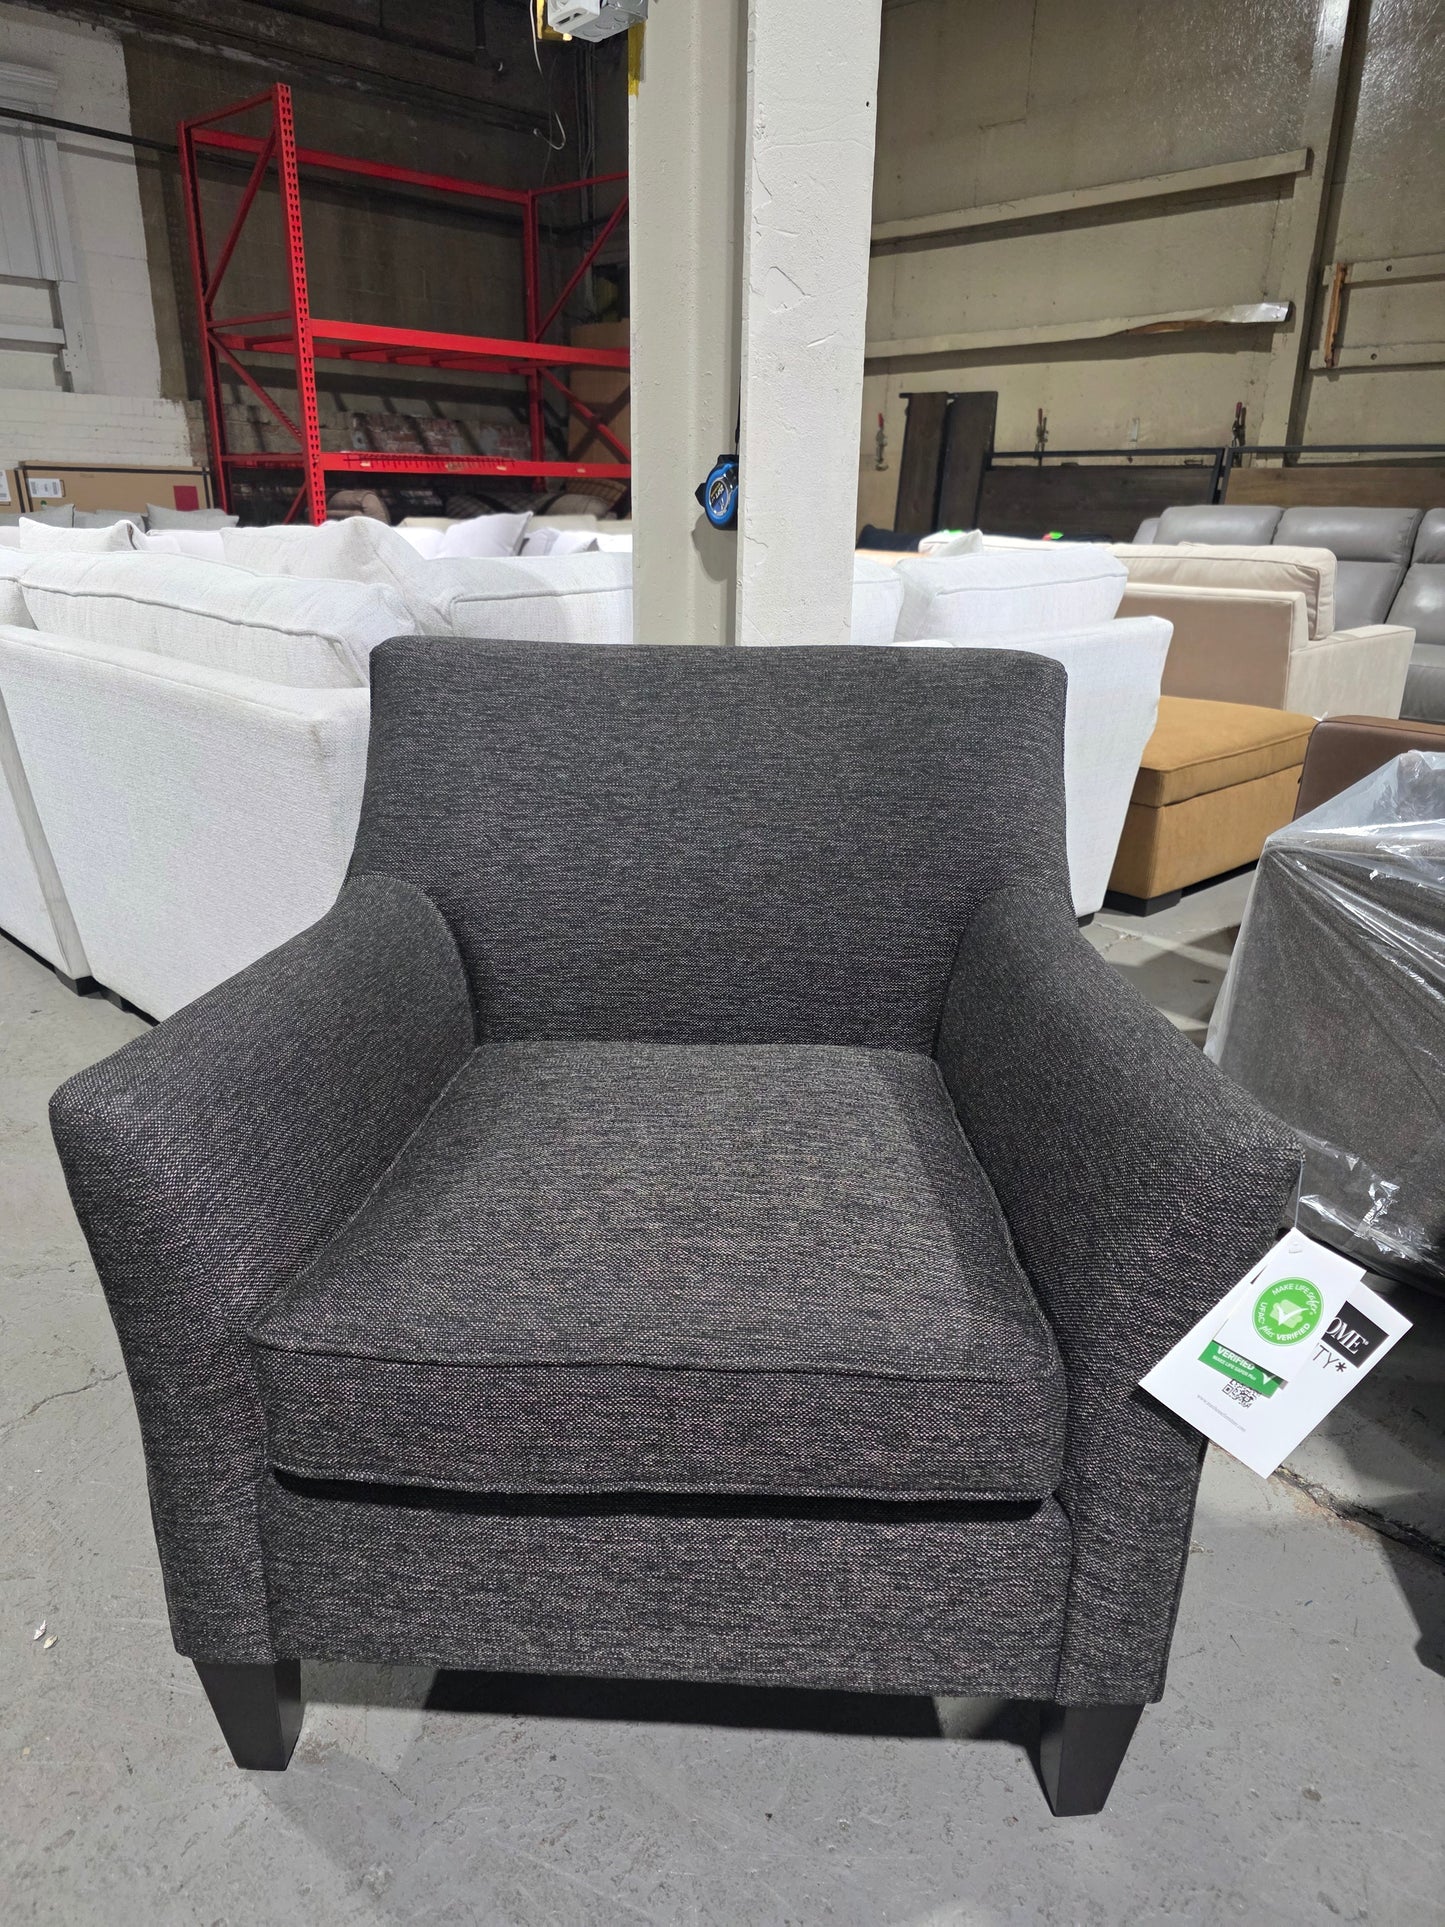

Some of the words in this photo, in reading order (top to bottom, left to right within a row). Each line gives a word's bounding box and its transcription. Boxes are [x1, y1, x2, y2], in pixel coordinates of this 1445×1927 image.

[1272, 1283, 1294, 1296] MAKE
[1295, 1284, 1310, 1295] LIFE
[1276, 1323, 1310, 1341] VERIFIED
[1217, 1346, 1256, 1371] VERIFIED
